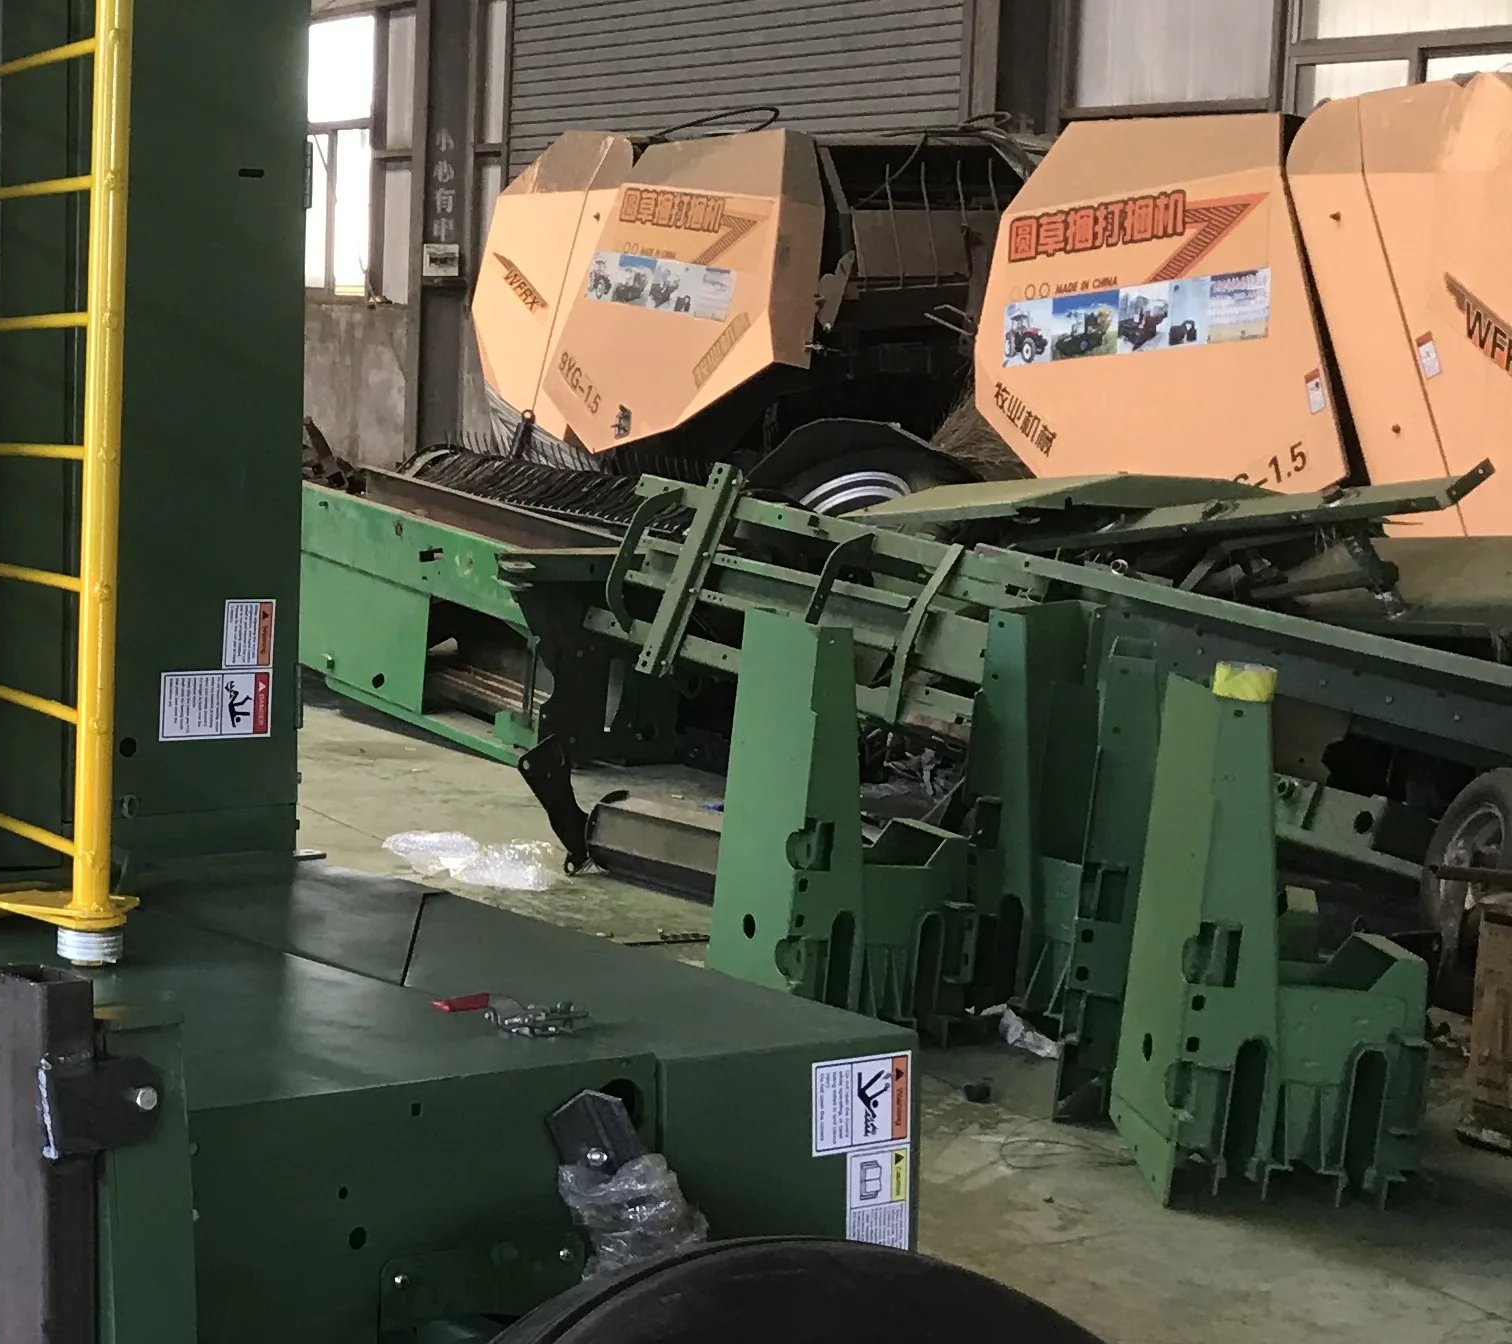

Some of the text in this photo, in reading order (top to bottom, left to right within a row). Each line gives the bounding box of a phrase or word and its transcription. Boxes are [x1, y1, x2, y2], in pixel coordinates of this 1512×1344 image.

[1008, 189, 1186, 263] 圆草捆打捆机
[504, 269, 541, 311] WFRX
[1055, 276, 1118, 295] MADE IN CHINA
[558, 351, 601, 414] 9YG-1.5
[994, 381, 1057, 457] 牧业机械
[894, 1087, 904, 1126] Warning
